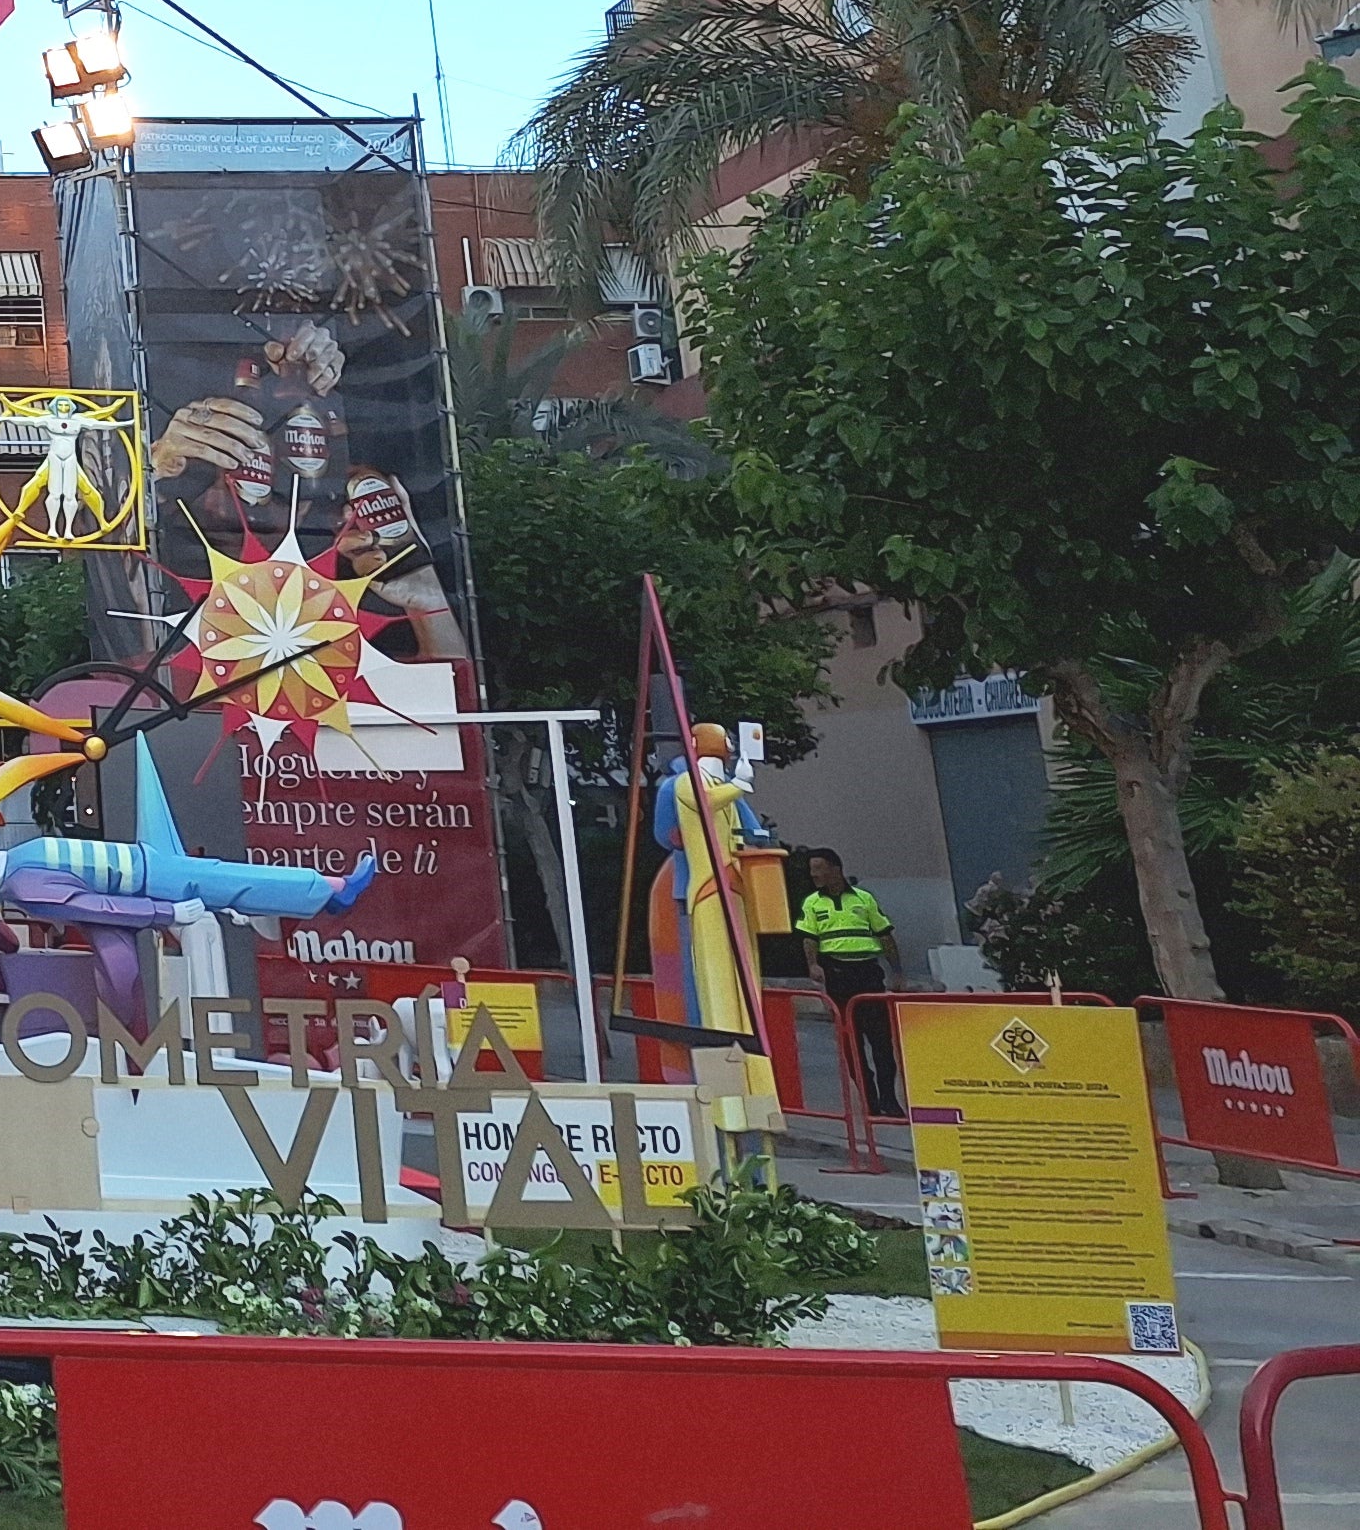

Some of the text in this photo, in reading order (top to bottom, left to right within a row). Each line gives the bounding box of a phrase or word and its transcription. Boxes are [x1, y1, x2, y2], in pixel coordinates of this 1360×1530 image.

[234, 144, 258, 154] SANT
[260, 145, 285, 154] JOAN
[367, 791, 473, 828] serán
[246, 837, 439, 875] parte de ti
[287, 929, 416, 965] Mahou
[1202, 1046, 1295, 1096] Mahou
[592, 1124, 681, 1154] RCTO
[218, 1086, 704, 1230] VITAL
